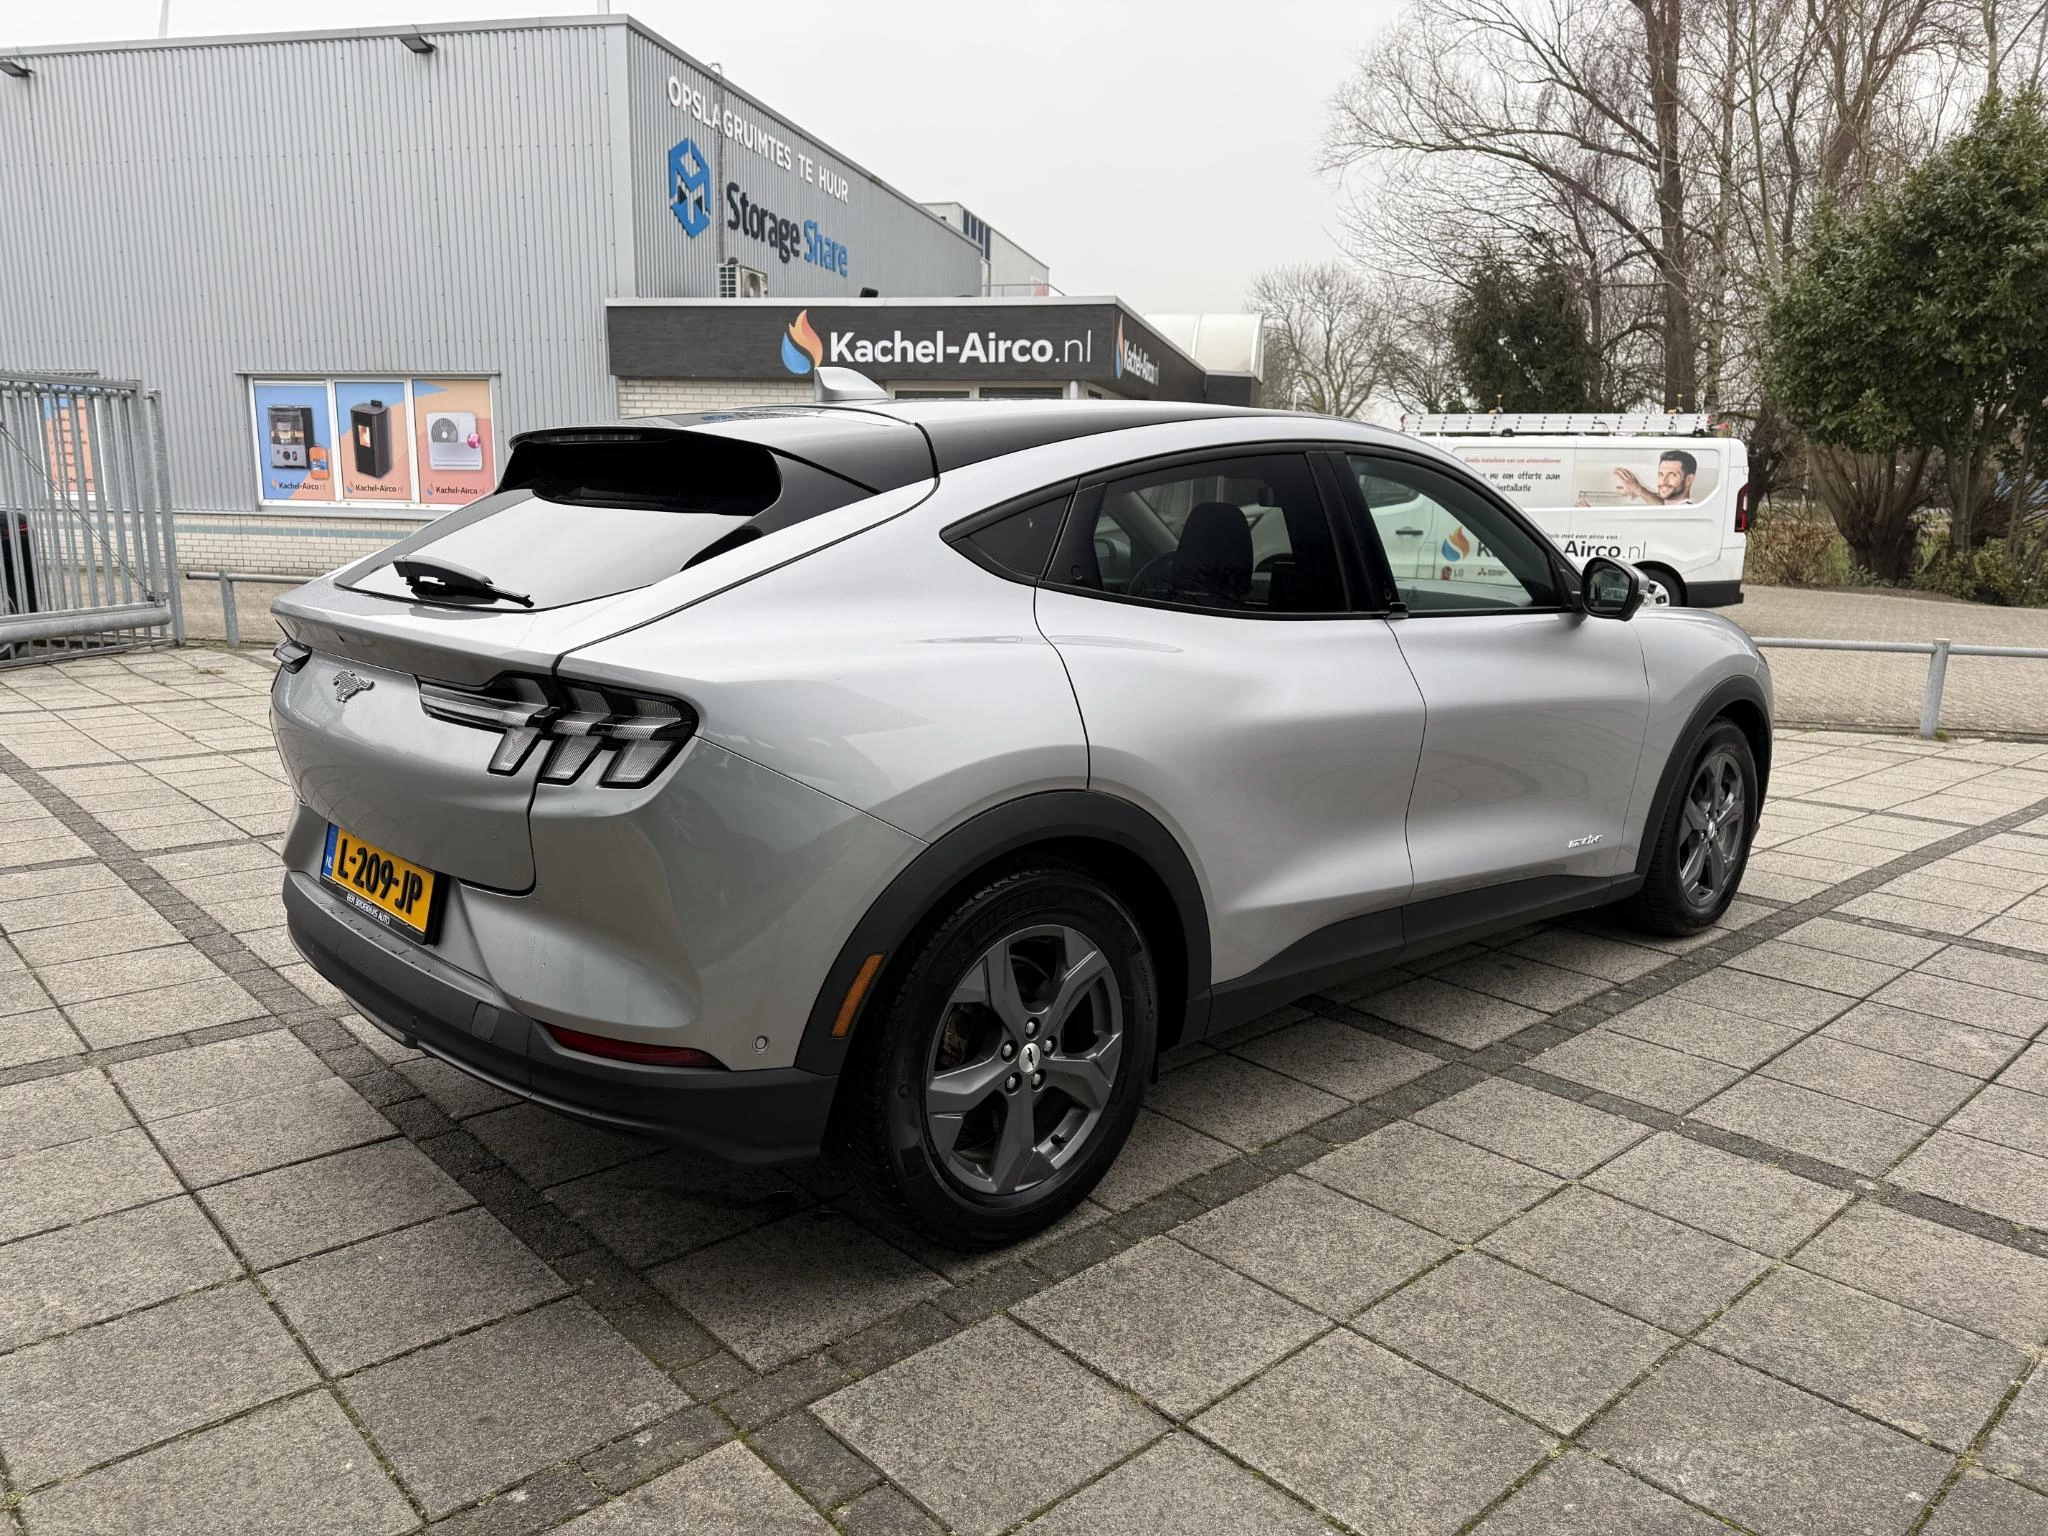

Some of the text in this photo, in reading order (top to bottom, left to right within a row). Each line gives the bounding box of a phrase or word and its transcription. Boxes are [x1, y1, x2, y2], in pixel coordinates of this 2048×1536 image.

[668, 76, 848, 203] OPSLAGRUIMTES TE HUUR
[727, 182, 848, 277] Storage Share
[830, 329, 1092, 364] Kachel-Airco.nl
[1517, 471, 1542, 480] offerte
[338, 838, 423, 915] L-209-JP
